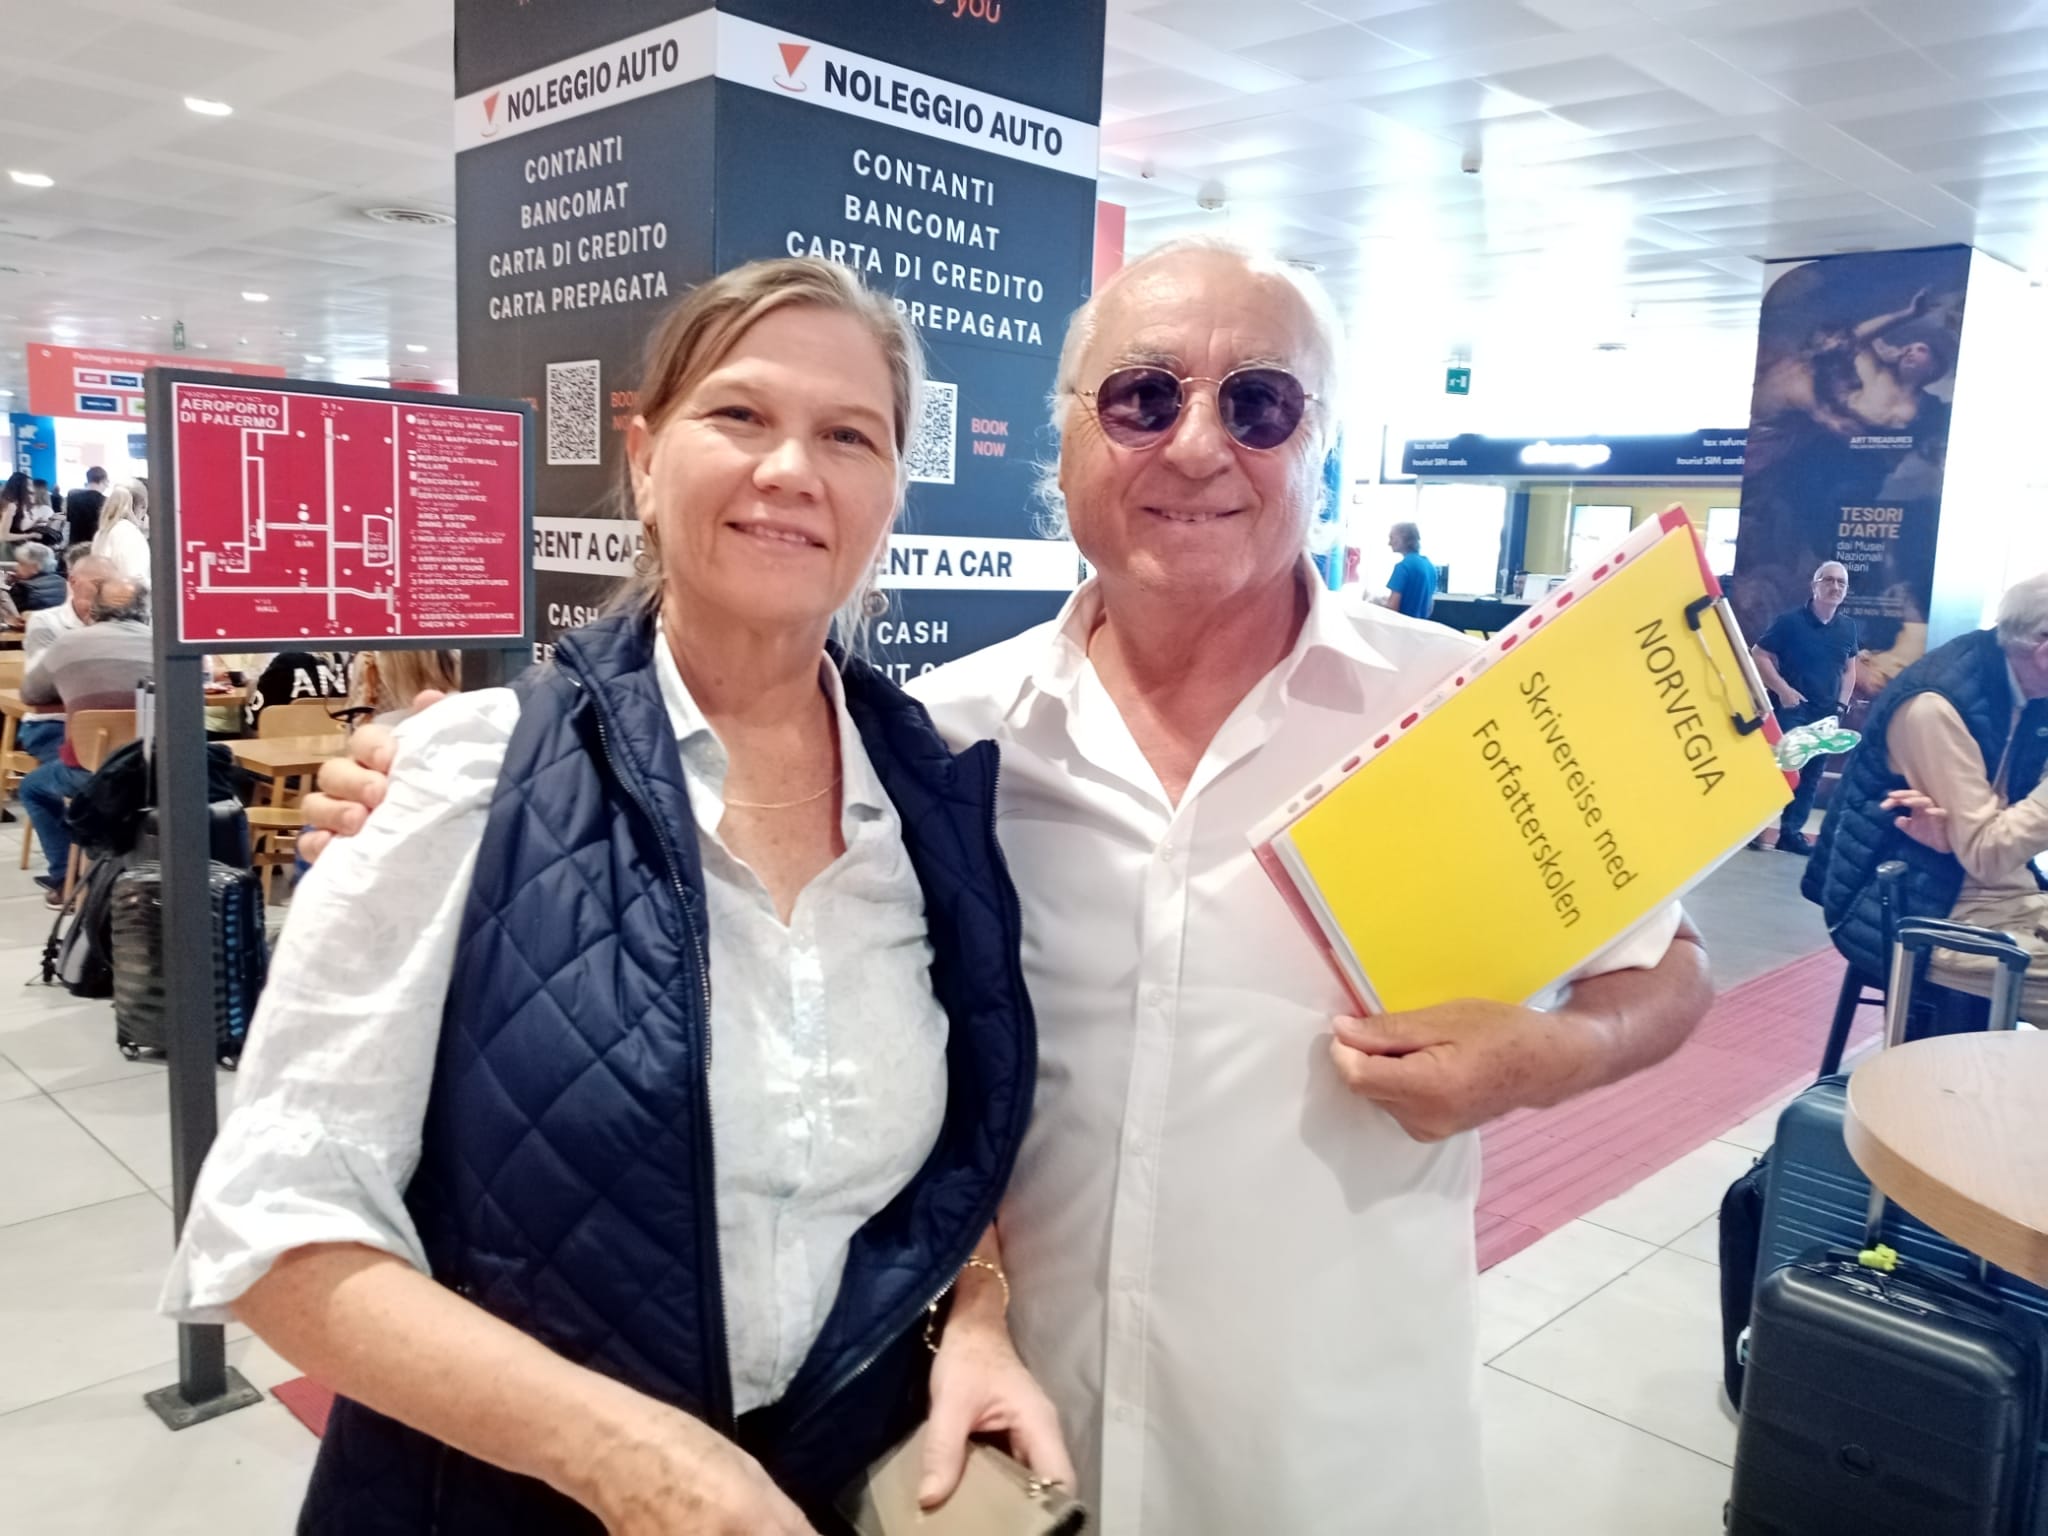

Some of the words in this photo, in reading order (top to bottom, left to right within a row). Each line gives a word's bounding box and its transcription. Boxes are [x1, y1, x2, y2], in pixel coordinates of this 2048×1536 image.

[507, 62, 610, 122] NOLEGGIO
[617, 38, 679, 88] AUTO
[824, 60, 983, 133] NOLEGGIO
[990, 112, 1062, 156] AUTO
[525, 136, 623, 184] CONTANTI
[853, 149, 995, 206] CONTANTI
[521, 182, 629, 230] BANCOMAT
[845, 194, 1000, 251] BANCOMAT
[489, 247, 546, 278] CARTA
[552, 241, 571, 267] DI
[578, 223, 668, 261] CREDITO
[786, 231, 883, 275] CARTA
[896, 252, 922, 282] DI
[932, 261, 1044, 304] CREDITO
[489, 291, 545, 320] CARTA
[551, 272, 669, 311] PREPAGATA
[180, 398, 280, 416] AEROPORTO
[180, 411, 197, 423] DI
[201, 412, 277, 429] PALERMO
[971, 417, 1009, 437] BOOK
[973, 440, 1006, 457] NOW
[1838, 523, 1901, 539] D'ARTE
[1840, 507, 1904, 522] TESORI
[533, 530, 583, 560] RENT
[587, 532, 601, 561] A
[934, 549, 953, 576] A
[959, 550, 1012, 577] CAR
[1855, 541, 1885, 551] Musei
[547, 602, 599, 628] CASH
[876, 620, 949, 645] CASH
[1635, 618, 1726, 797] NORVEGIA
[1519, 671, 1602, 829] Skrivereise
[1596, 827, 1639, 891] med
[1472, 718, 1582, 929] Forfatterskolen
